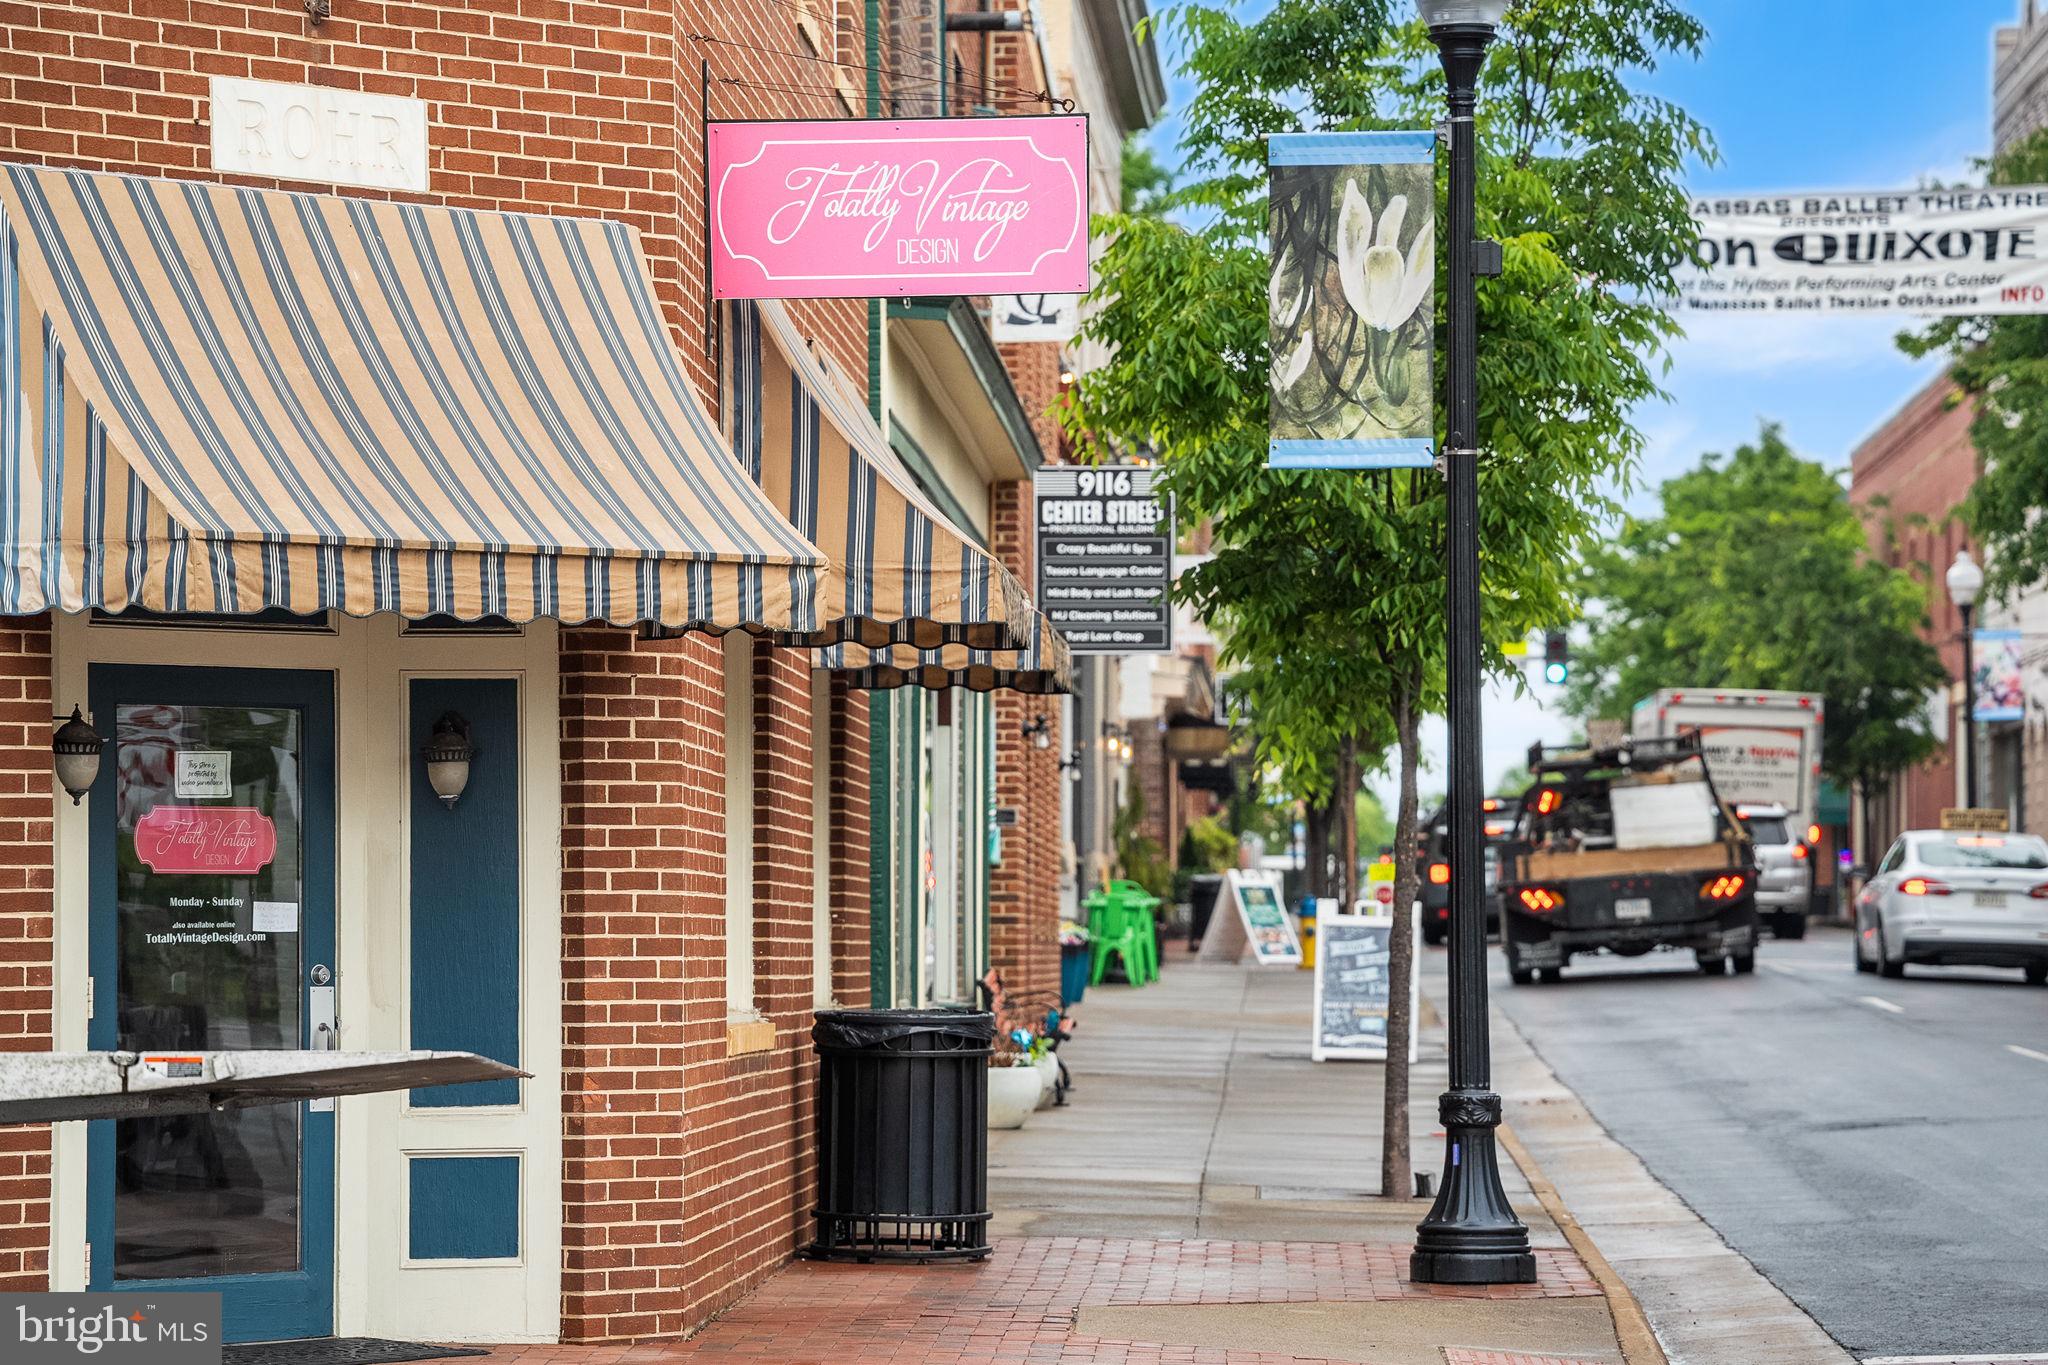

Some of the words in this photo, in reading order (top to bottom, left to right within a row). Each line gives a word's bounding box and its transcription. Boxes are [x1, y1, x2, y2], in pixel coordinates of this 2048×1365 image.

[237, 98, 406, 170] ROHR
[1693, 199, 1792, 215] ASSAS
[1803, 197, 1908, 214] BALLET
[1919, 191, 2048, 211] THEATRE
[767, 161, 901, 253] Totally
[899, 158, 1032, 262] Vintage
[896, 238, 959, 264] DESIGN
[1795, 274, 1897, 291] Performing
[1900, 274, 1937, 289] Arts
[1943, 272, 2007, 288] Center
[2000, 286, 2045, 303] INFO
[1077, 471, 1132, 497] 9116
[1041, 500, 1104, 524] CENTER
[1117, 523, 1156, 534] BUILDIN
[1132, 543, 1152, 556] Spa
[1079, 565, 1129, 578] Language
[1129, 565, 1164, 576] Center
[1092, 587, 1111, 598] and
[1068, 610, 1112, 623] Cleaning
[1113, 610, 1158, 620] Solutions
[1090, 631, 1112, 641] Law
[1112, 631, 1144, 643] Group
[187, 760, 198, 769] This
[210, 769, 217, 779] by
[156, 818, 207, 860] Totally
[206, 818, 257, 866] Vintage
[205, 853, 230, 865] DESIGN
[169, 897, 205, 908] Monday
[212, 896, 244, 908] Sunday
[172, 921, 186, 929] also
[187, 921, 215, 929] available
[216, 920, 236, 928] online
[145, 931, 266, 945] TotallyVintageDesign.com
